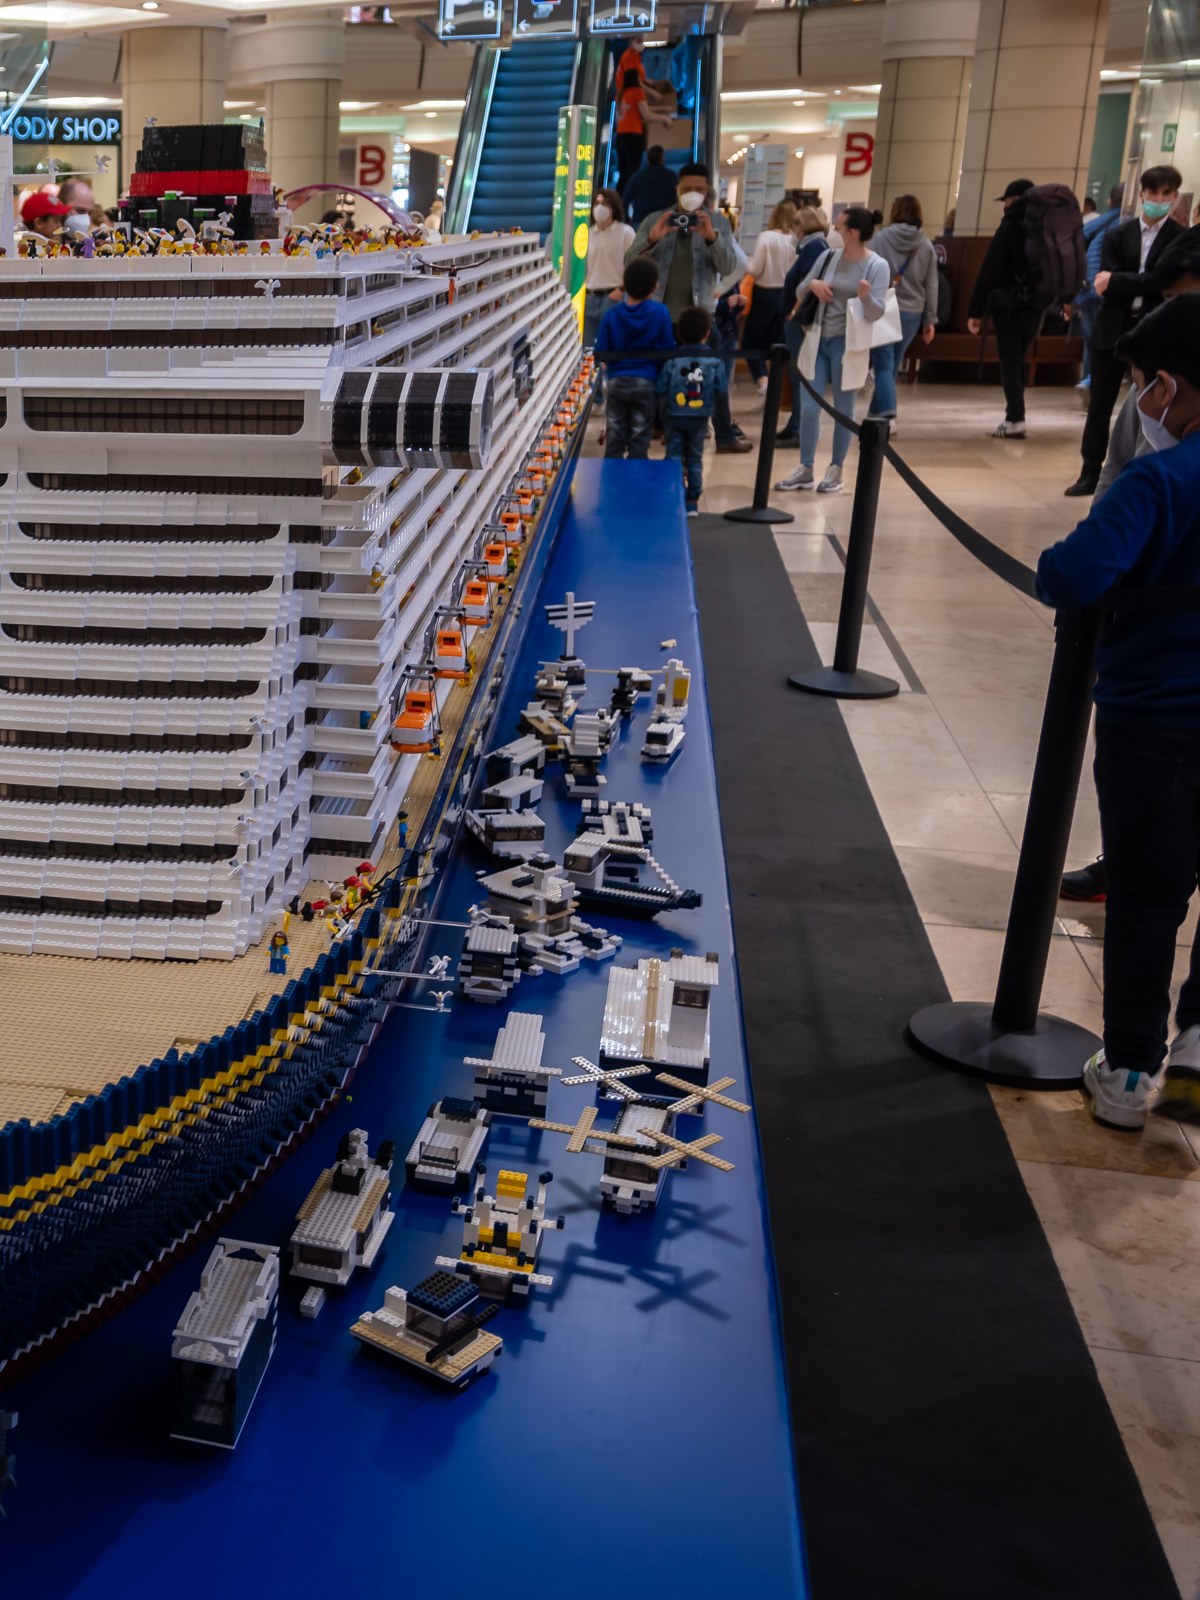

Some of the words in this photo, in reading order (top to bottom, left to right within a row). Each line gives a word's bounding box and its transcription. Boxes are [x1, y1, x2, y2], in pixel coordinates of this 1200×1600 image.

[483, 0, 496, 19] B
[1, 116, 58, 140] ODY
[62, 116, 119, 141] SHOP
[360, 145, 386, 186] B
[843, 132, 875, 177] B
